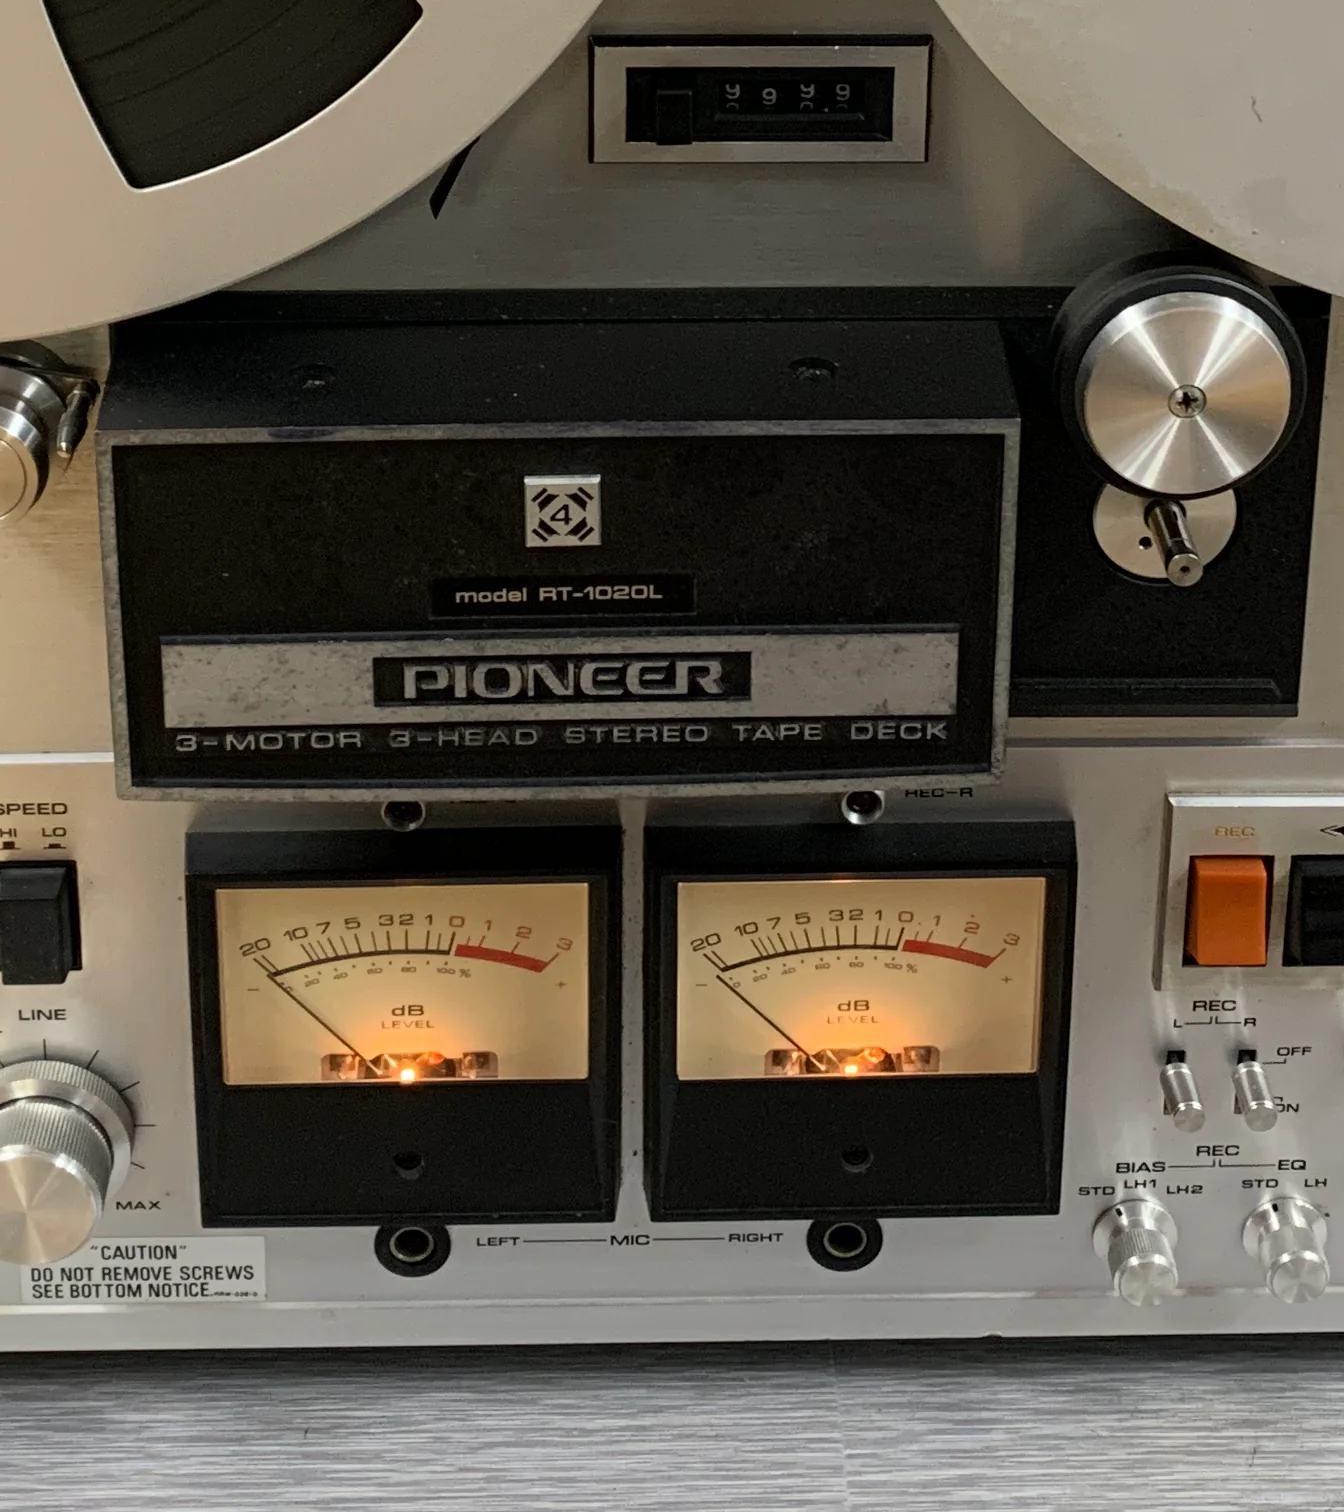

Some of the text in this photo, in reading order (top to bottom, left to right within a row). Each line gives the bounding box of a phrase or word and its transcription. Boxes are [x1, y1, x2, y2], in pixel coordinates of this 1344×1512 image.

[455, 584, 663, 604] model RT-1020L
[402, 660, 724, 700] PIONEER
[175, 720, 948, 752] 3-MOTOR 3-HEAD STEREO TAPE DECK
[41, 826, 67, 838] LO
[1214, 825, 1256, 838] REC
[239, 913, 573, 957] 20 10 7 5 3 2 1 0 1 2 3
[690, 908, 1020, 952] 20 10 7 5 3 2 1 0 1 2 3
[391, 1004, 425, 1017] dB
[837, 999, 870, 1012] dB
[1192, 1000, 1237, 1012] REC
[18, 1008, 68, 1021] LINE
[381, 1019, 435, 1029] LEVEL
[1173, 1017, 1257, 1028] L R
[1276, 1046, 1312, 1057] OFF
[1196, 1145, 1240, 1157] REC
[1116, 1159, 1307, 1174] BIAS EQ
[1078, 1179, 1204, 1196] STD LH1 LH2
[1241, 1178, 1328, 1189] STD LH
[115, 1199, 162, 1212] MAX
[476, 1231, 784, 1248] LEFT MIC RIGHT
[31, 1265, 255, 1283] DO NOT REMOVE SCREWS
[32, 1284, 65, 1299] SEE
[69, 1283, 143, 1299] BOTTOM
